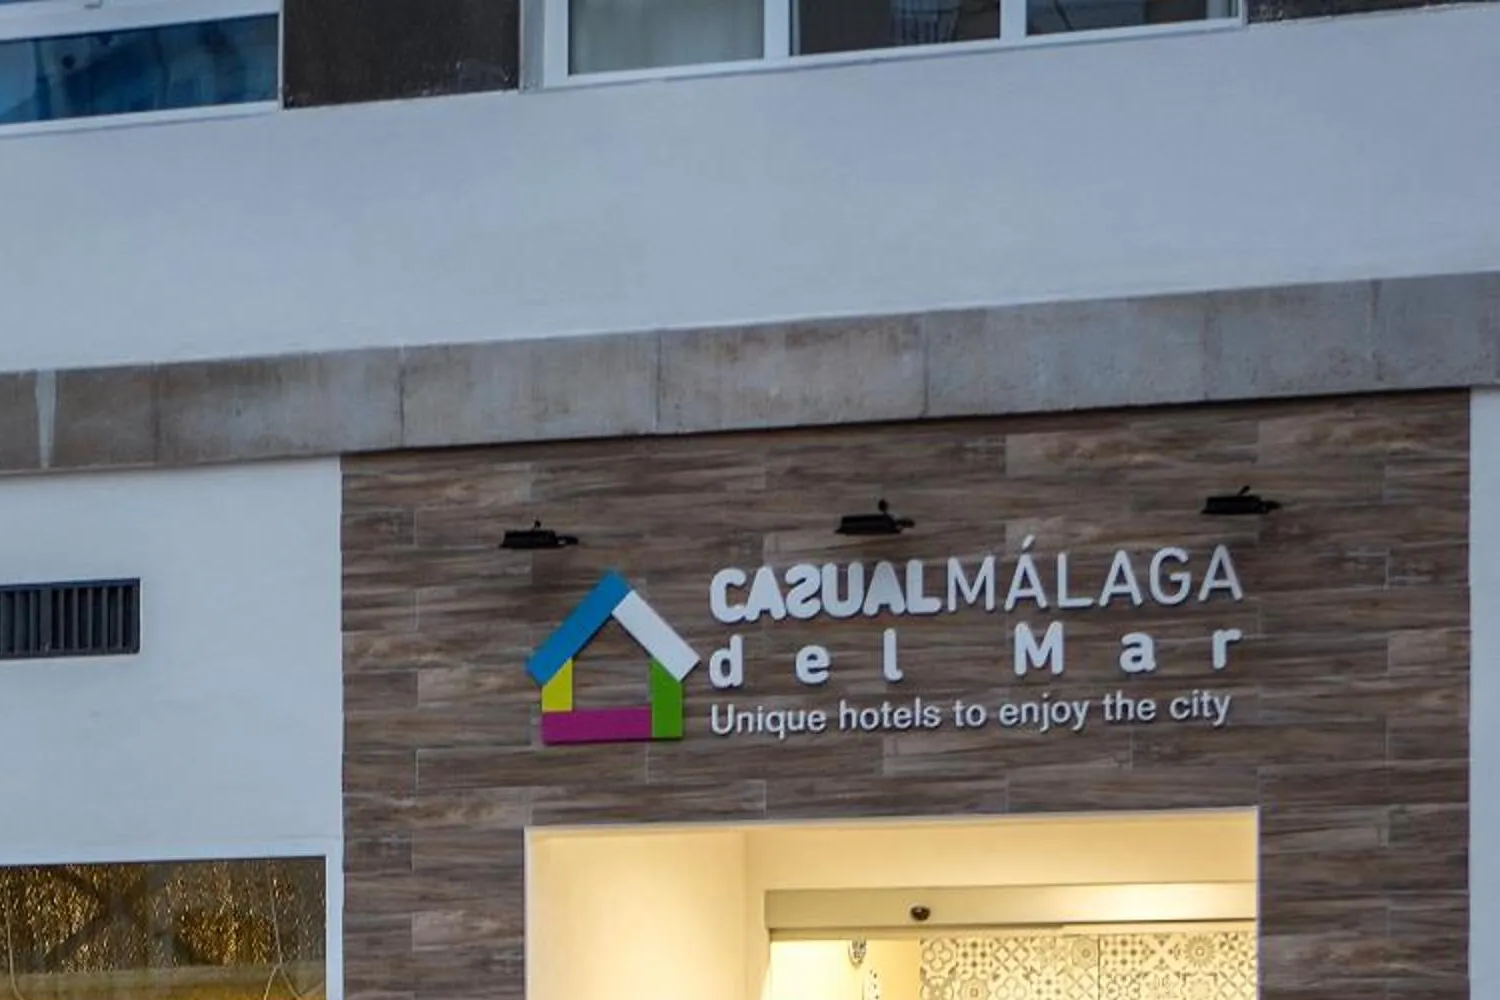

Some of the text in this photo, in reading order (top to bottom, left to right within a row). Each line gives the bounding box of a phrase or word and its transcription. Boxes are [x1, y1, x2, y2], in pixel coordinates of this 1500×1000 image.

[708, 621, 1243, 689] del Mar
[711, 689, 1231, 740] Unique hotels to enjoy the city
